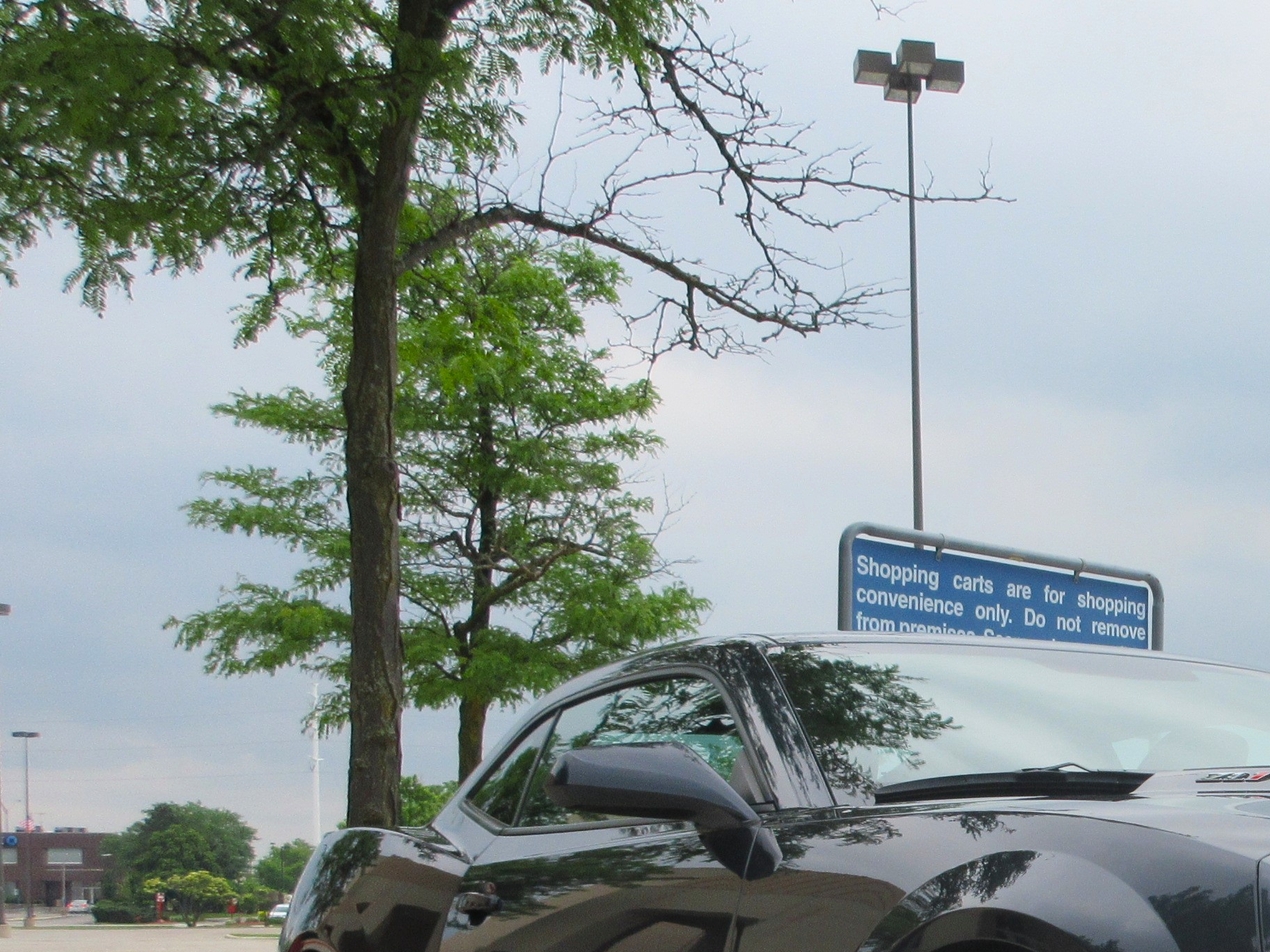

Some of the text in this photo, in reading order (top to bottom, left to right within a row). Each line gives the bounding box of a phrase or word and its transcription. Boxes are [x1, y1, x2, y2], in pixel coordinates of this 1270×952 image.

[856, 587, 1146, 640] convenience only. Do not remove
[857, 555, 1146, 620] Shopping carts are for shopping
[856, 611, 895, 631] from
